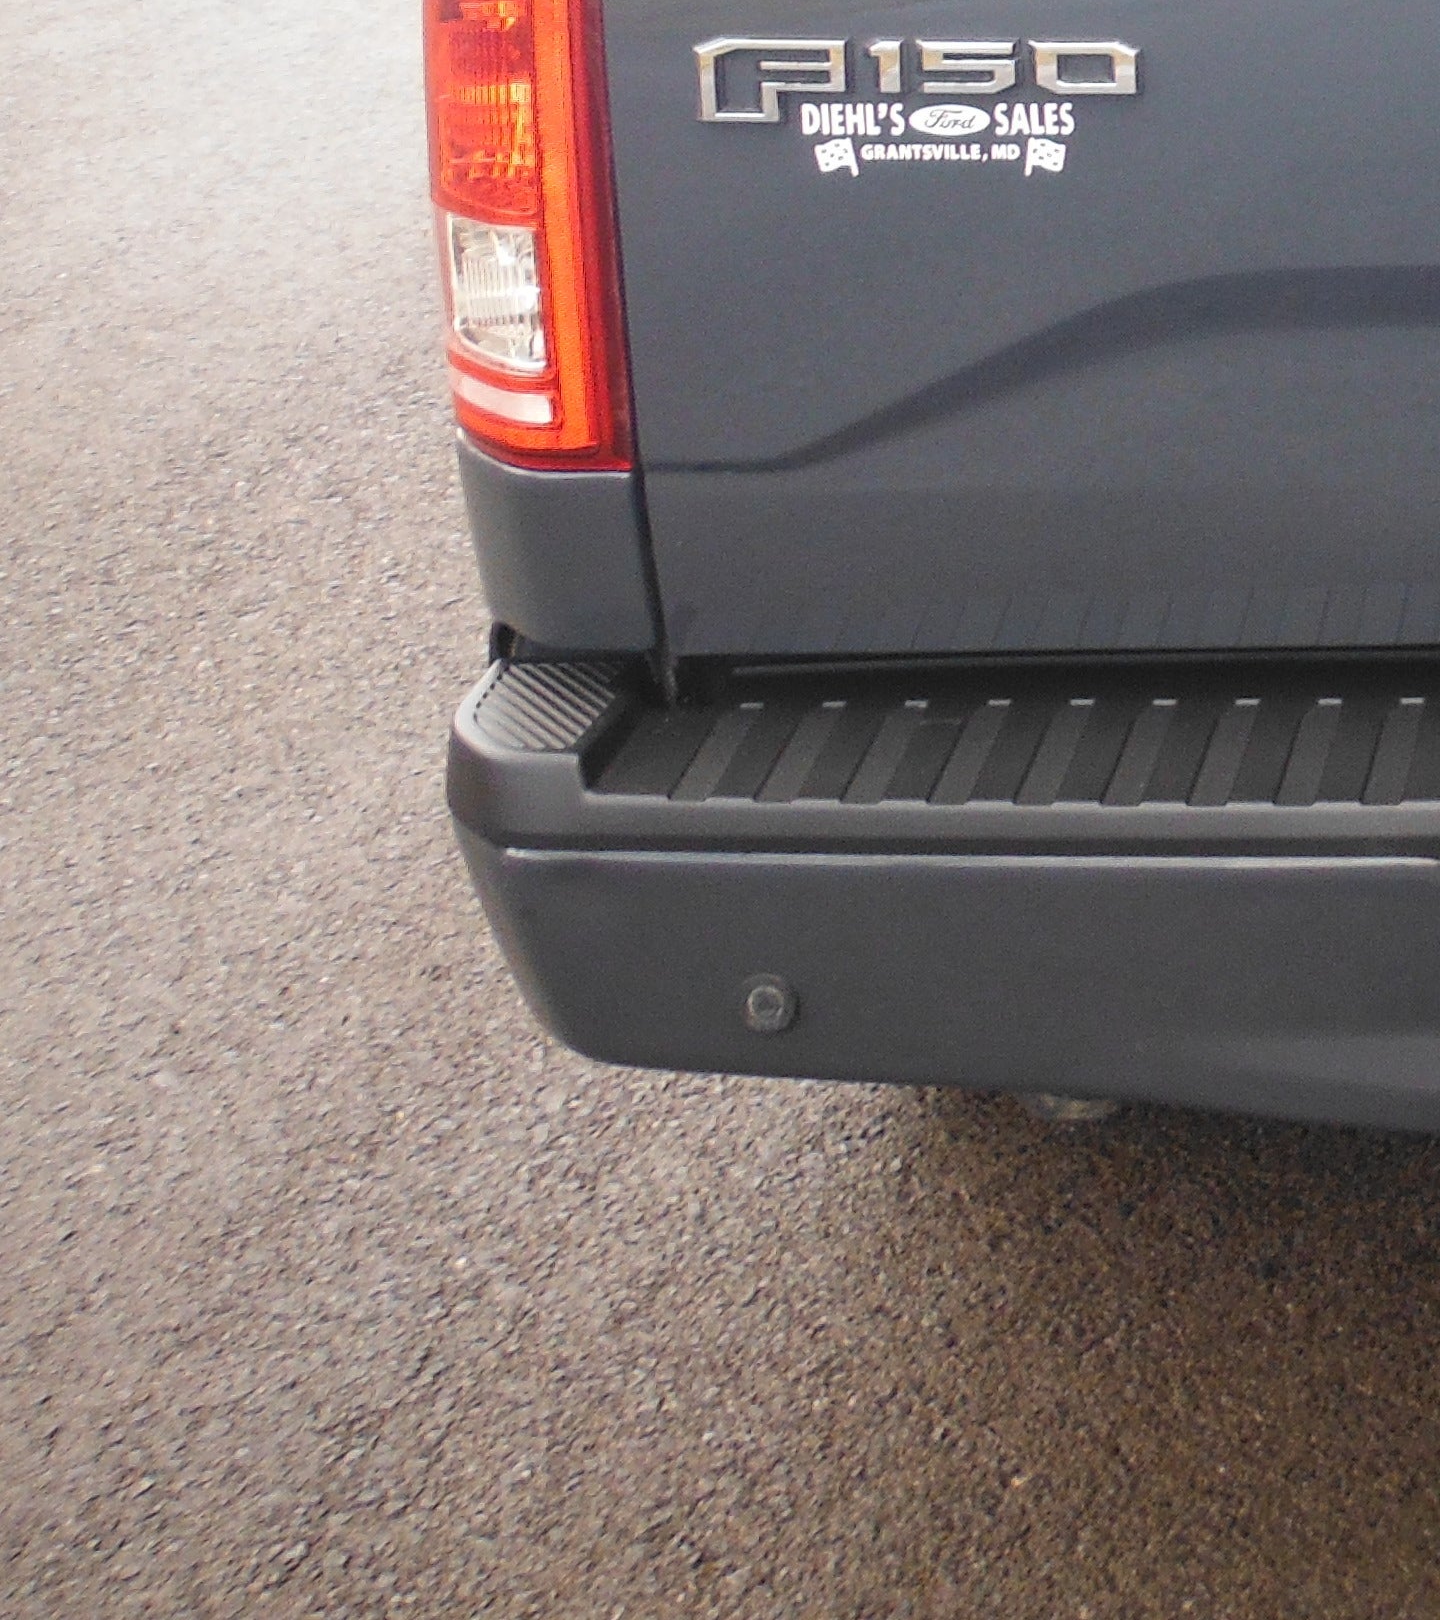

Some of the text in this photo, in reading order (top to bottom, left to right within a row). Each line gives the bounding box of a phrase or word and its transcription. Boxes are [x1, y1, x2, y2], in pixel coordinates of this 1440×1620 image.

[801, 102, 1075, 136] DIEHL'S Ford SALES
[860, 143, 1020, 162] GRANTSVILLE, MD
